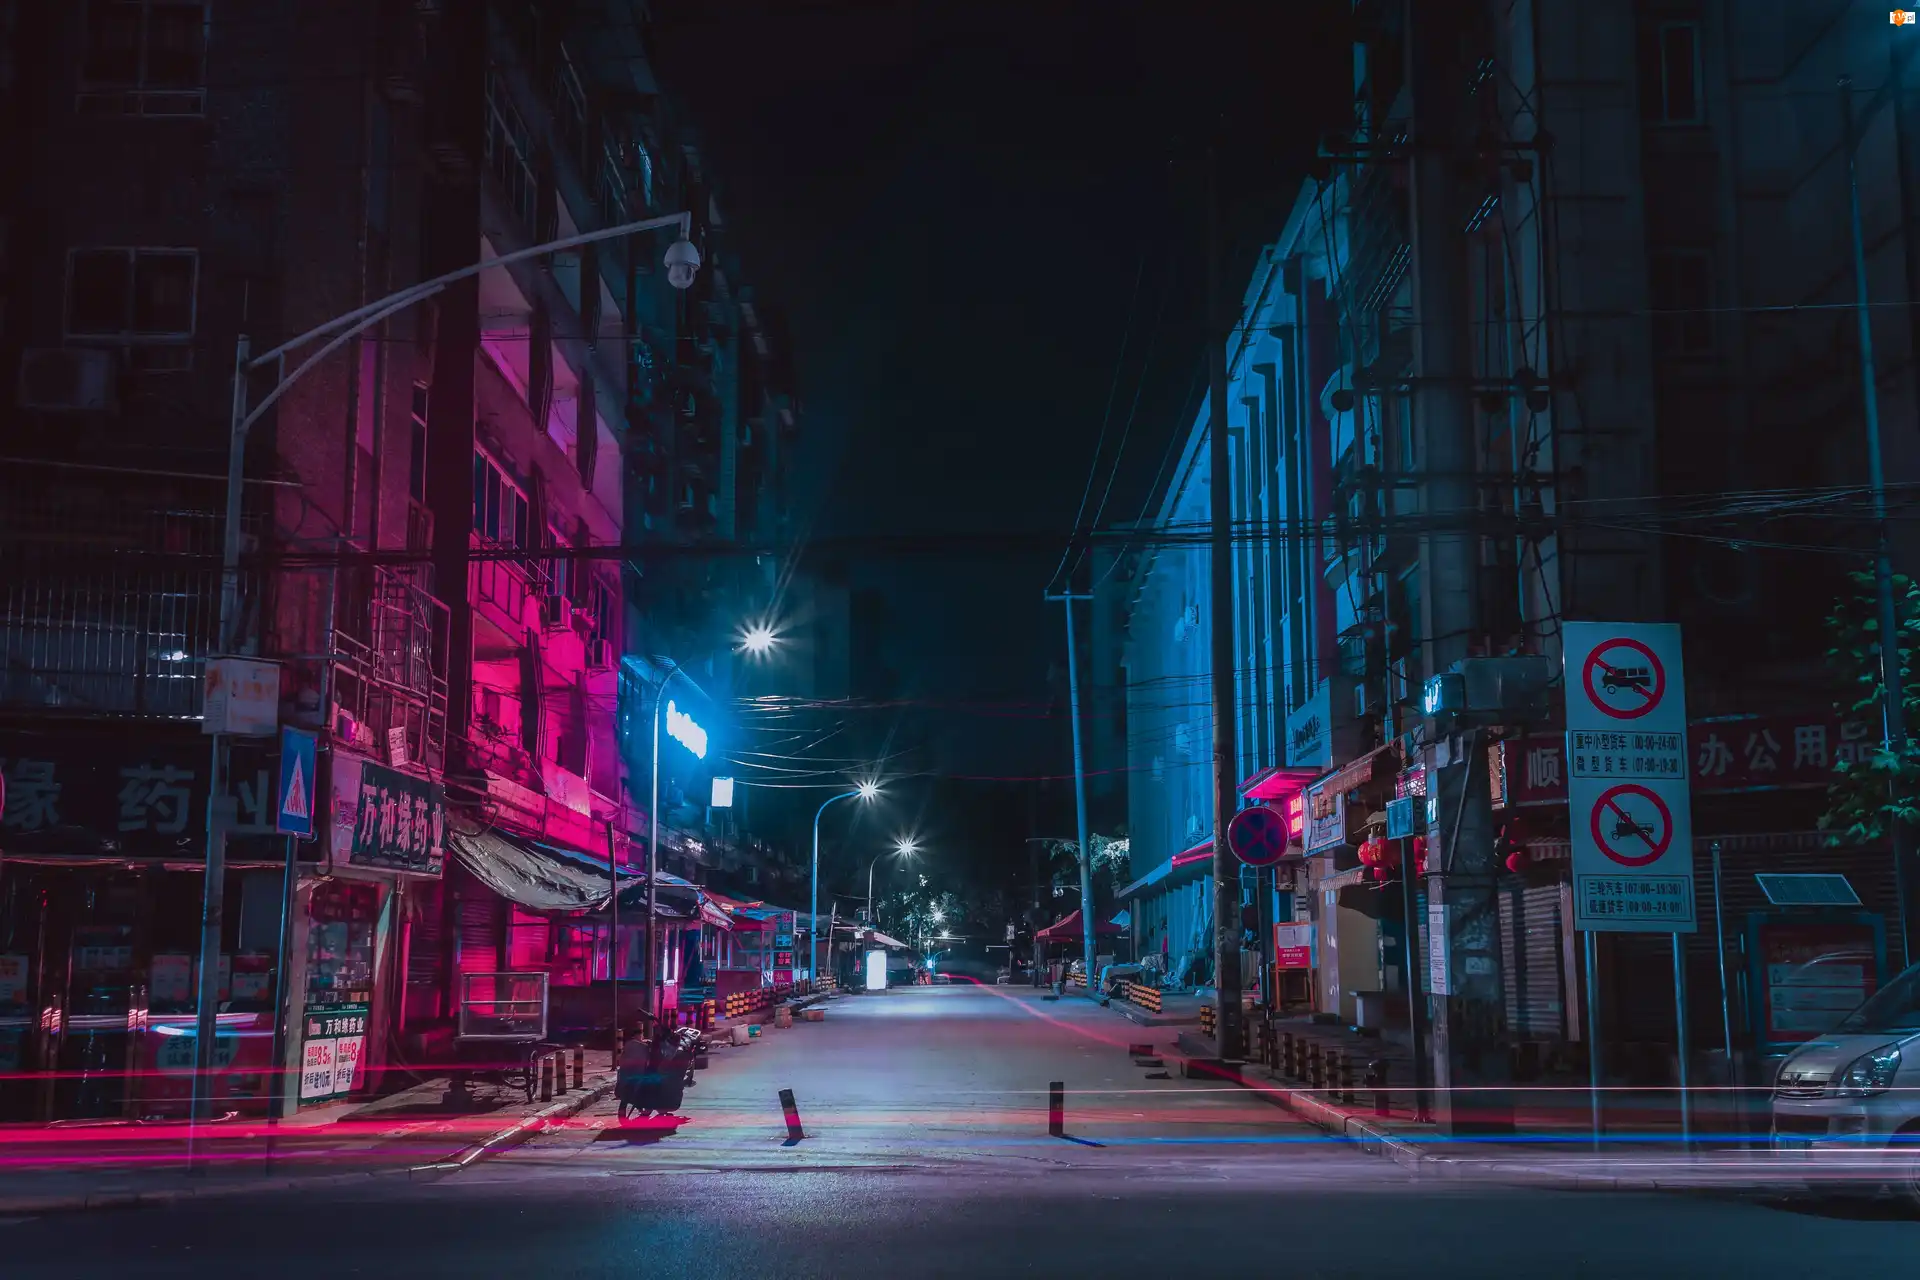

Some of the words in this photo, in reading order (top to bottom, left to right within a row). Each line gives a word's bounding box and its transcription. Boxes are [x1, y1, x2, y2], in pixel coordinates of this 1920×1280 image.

[1697, 721, 1873, 777] 办公用品
[360, 783, 444, 856] 万和缘药业
[325, 1016, 365, 1035] 万和缘药业
